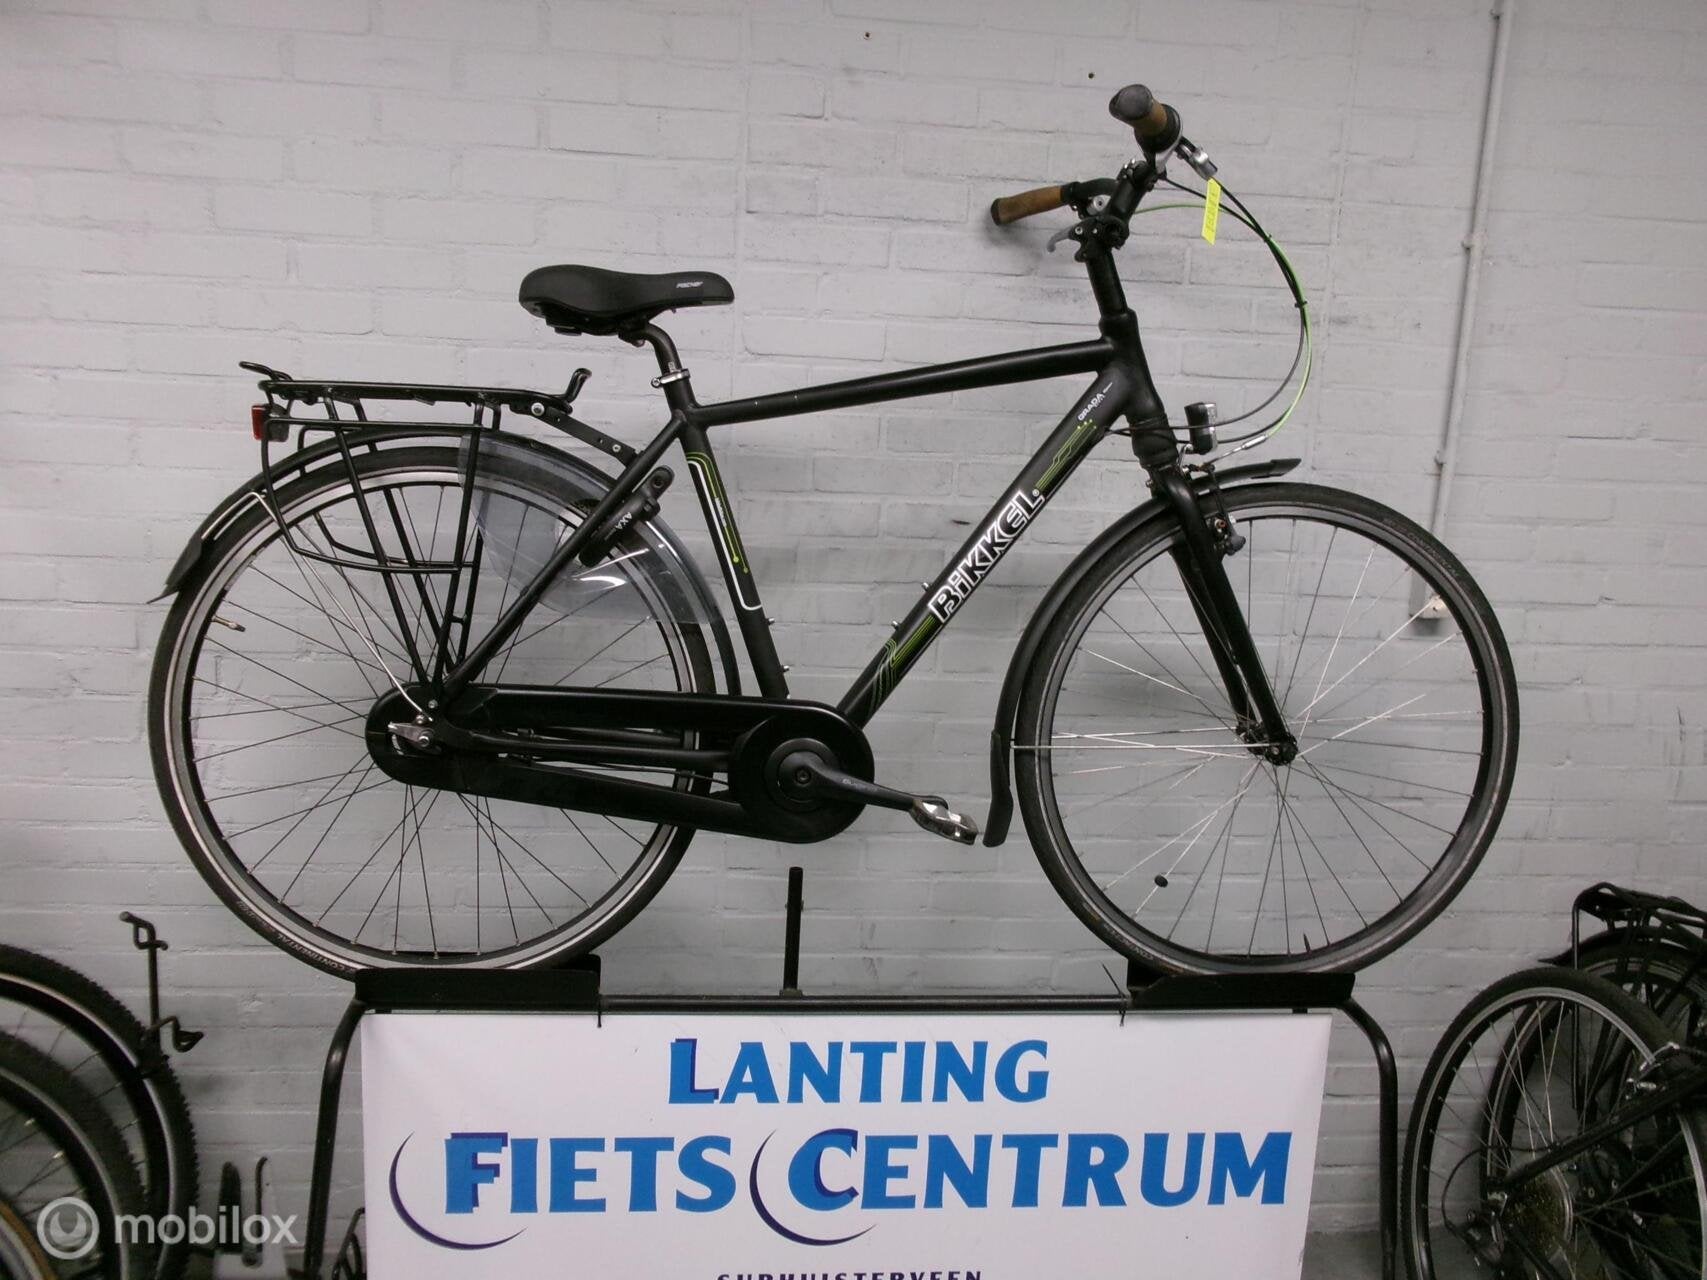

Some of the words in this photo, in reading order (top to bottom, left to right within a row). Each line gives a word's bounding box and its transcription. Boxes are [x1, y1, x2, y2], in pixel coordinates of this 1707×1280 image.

[615, 512, 632, 530] AXA
[668, 1038, 1050, 1106] LANTING
[445, 1132, 737, 1215] FIETS
[788, 1128, 1294, 1212] CENTRUM
